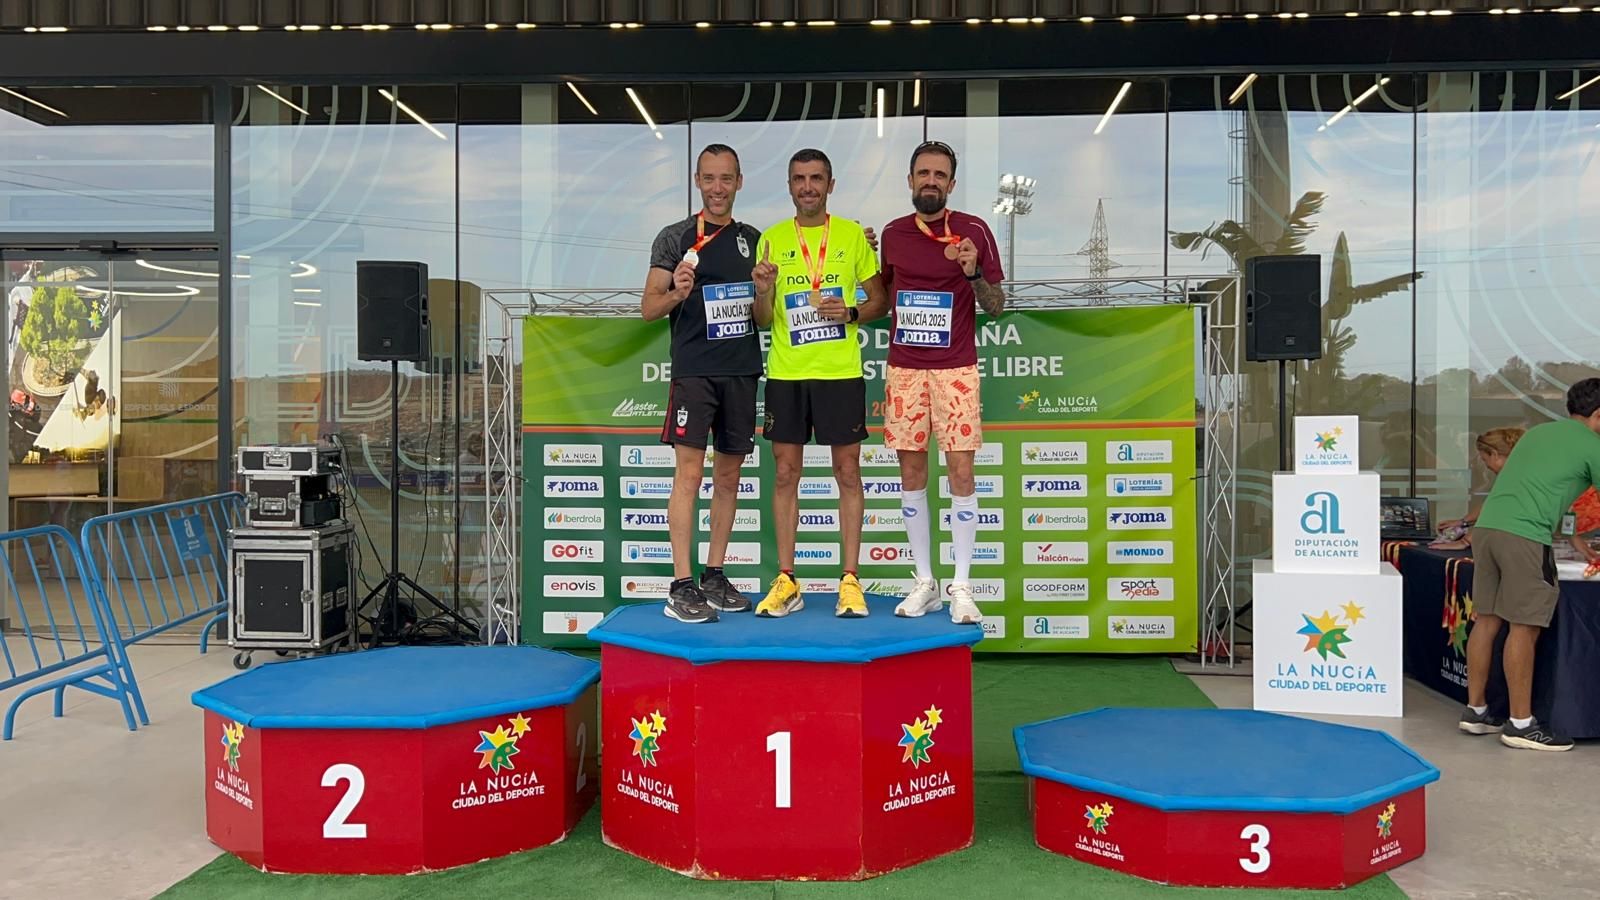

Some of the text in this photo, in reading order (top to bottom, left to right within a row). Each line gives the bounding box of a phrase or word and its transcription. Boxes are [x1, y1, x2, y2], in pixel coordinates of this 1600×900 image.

[712, 306, 721, 319] LA
[722, 302, 743, 318] NUCÍA
[792, 313, 801, 326] LA
[906, 311, 927, 325] NUCÍA
[929, 314, 946, 326] 2025
[992, 356, 1063, 377] LIBRE
[950, 379, 972, 395] NIKE
[1038, 397, 1051, 406] LA
[1046, 515, 1085, 523] Iberdrola
[1295, 538, 1358, 547] DIPUTACIÓN
[1310, 549, 1359, 558] ALICANTE
[551, 580, 596, 591] enovis
[1278, 663, 1298, 676] LA
[1443, 656, 1449, 670] LA
[1268, 679, 1386, 693] CIUDAD DEL DEPORTE
[575, 722, 587, 794] 2
[217, 766, 226, 781] LA
[622, 769, 633, 785] LA
[766, 731, 791, 808] 1
[460, 780, 478, 796] LA
[889, 782, 903, 798] LA
[235, 791, 253, 810] DEPORTE
[320, 763, 367, 839] 2
[452, 785, 545, 809] CIUDAD DEL DEPORTE
[617, 783, 680, 814] CIUDAD DEL DEPORTE
[883, 785, 956, 812] CIUDAD DEL DEPORTE
[1079, 835, 1089, 844] LA
[1102, 850, 1124, 861] DEPORTE
[1238, 824, 1271, 873] 3
[1372, 847, 1380, 857] LA
